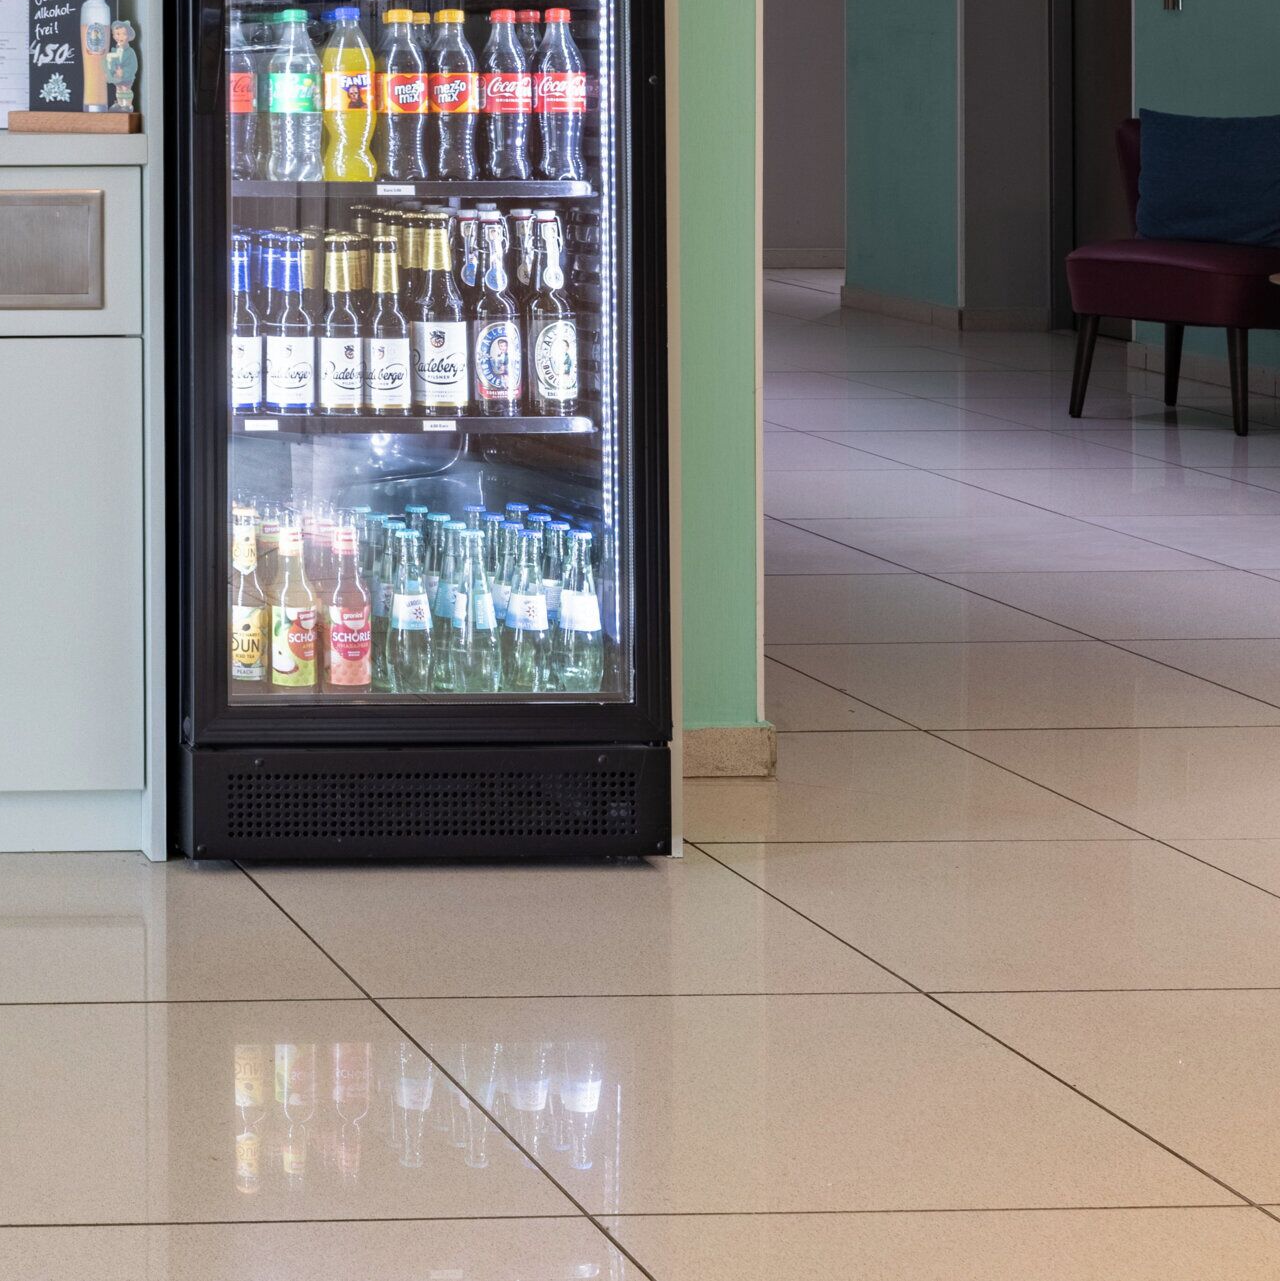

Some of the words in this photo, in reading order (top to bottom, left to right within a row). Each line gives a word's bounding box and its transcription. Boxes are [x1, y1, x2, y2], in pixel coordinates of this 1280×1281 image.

[34, 3, 77, 20] alkohol-
[34, 21, 59, 40] frei!
[434, 79, 467, 94] mezzo
[437, 91, 459, 104] mix
[332, 631, 371, 643] SCHORLE
